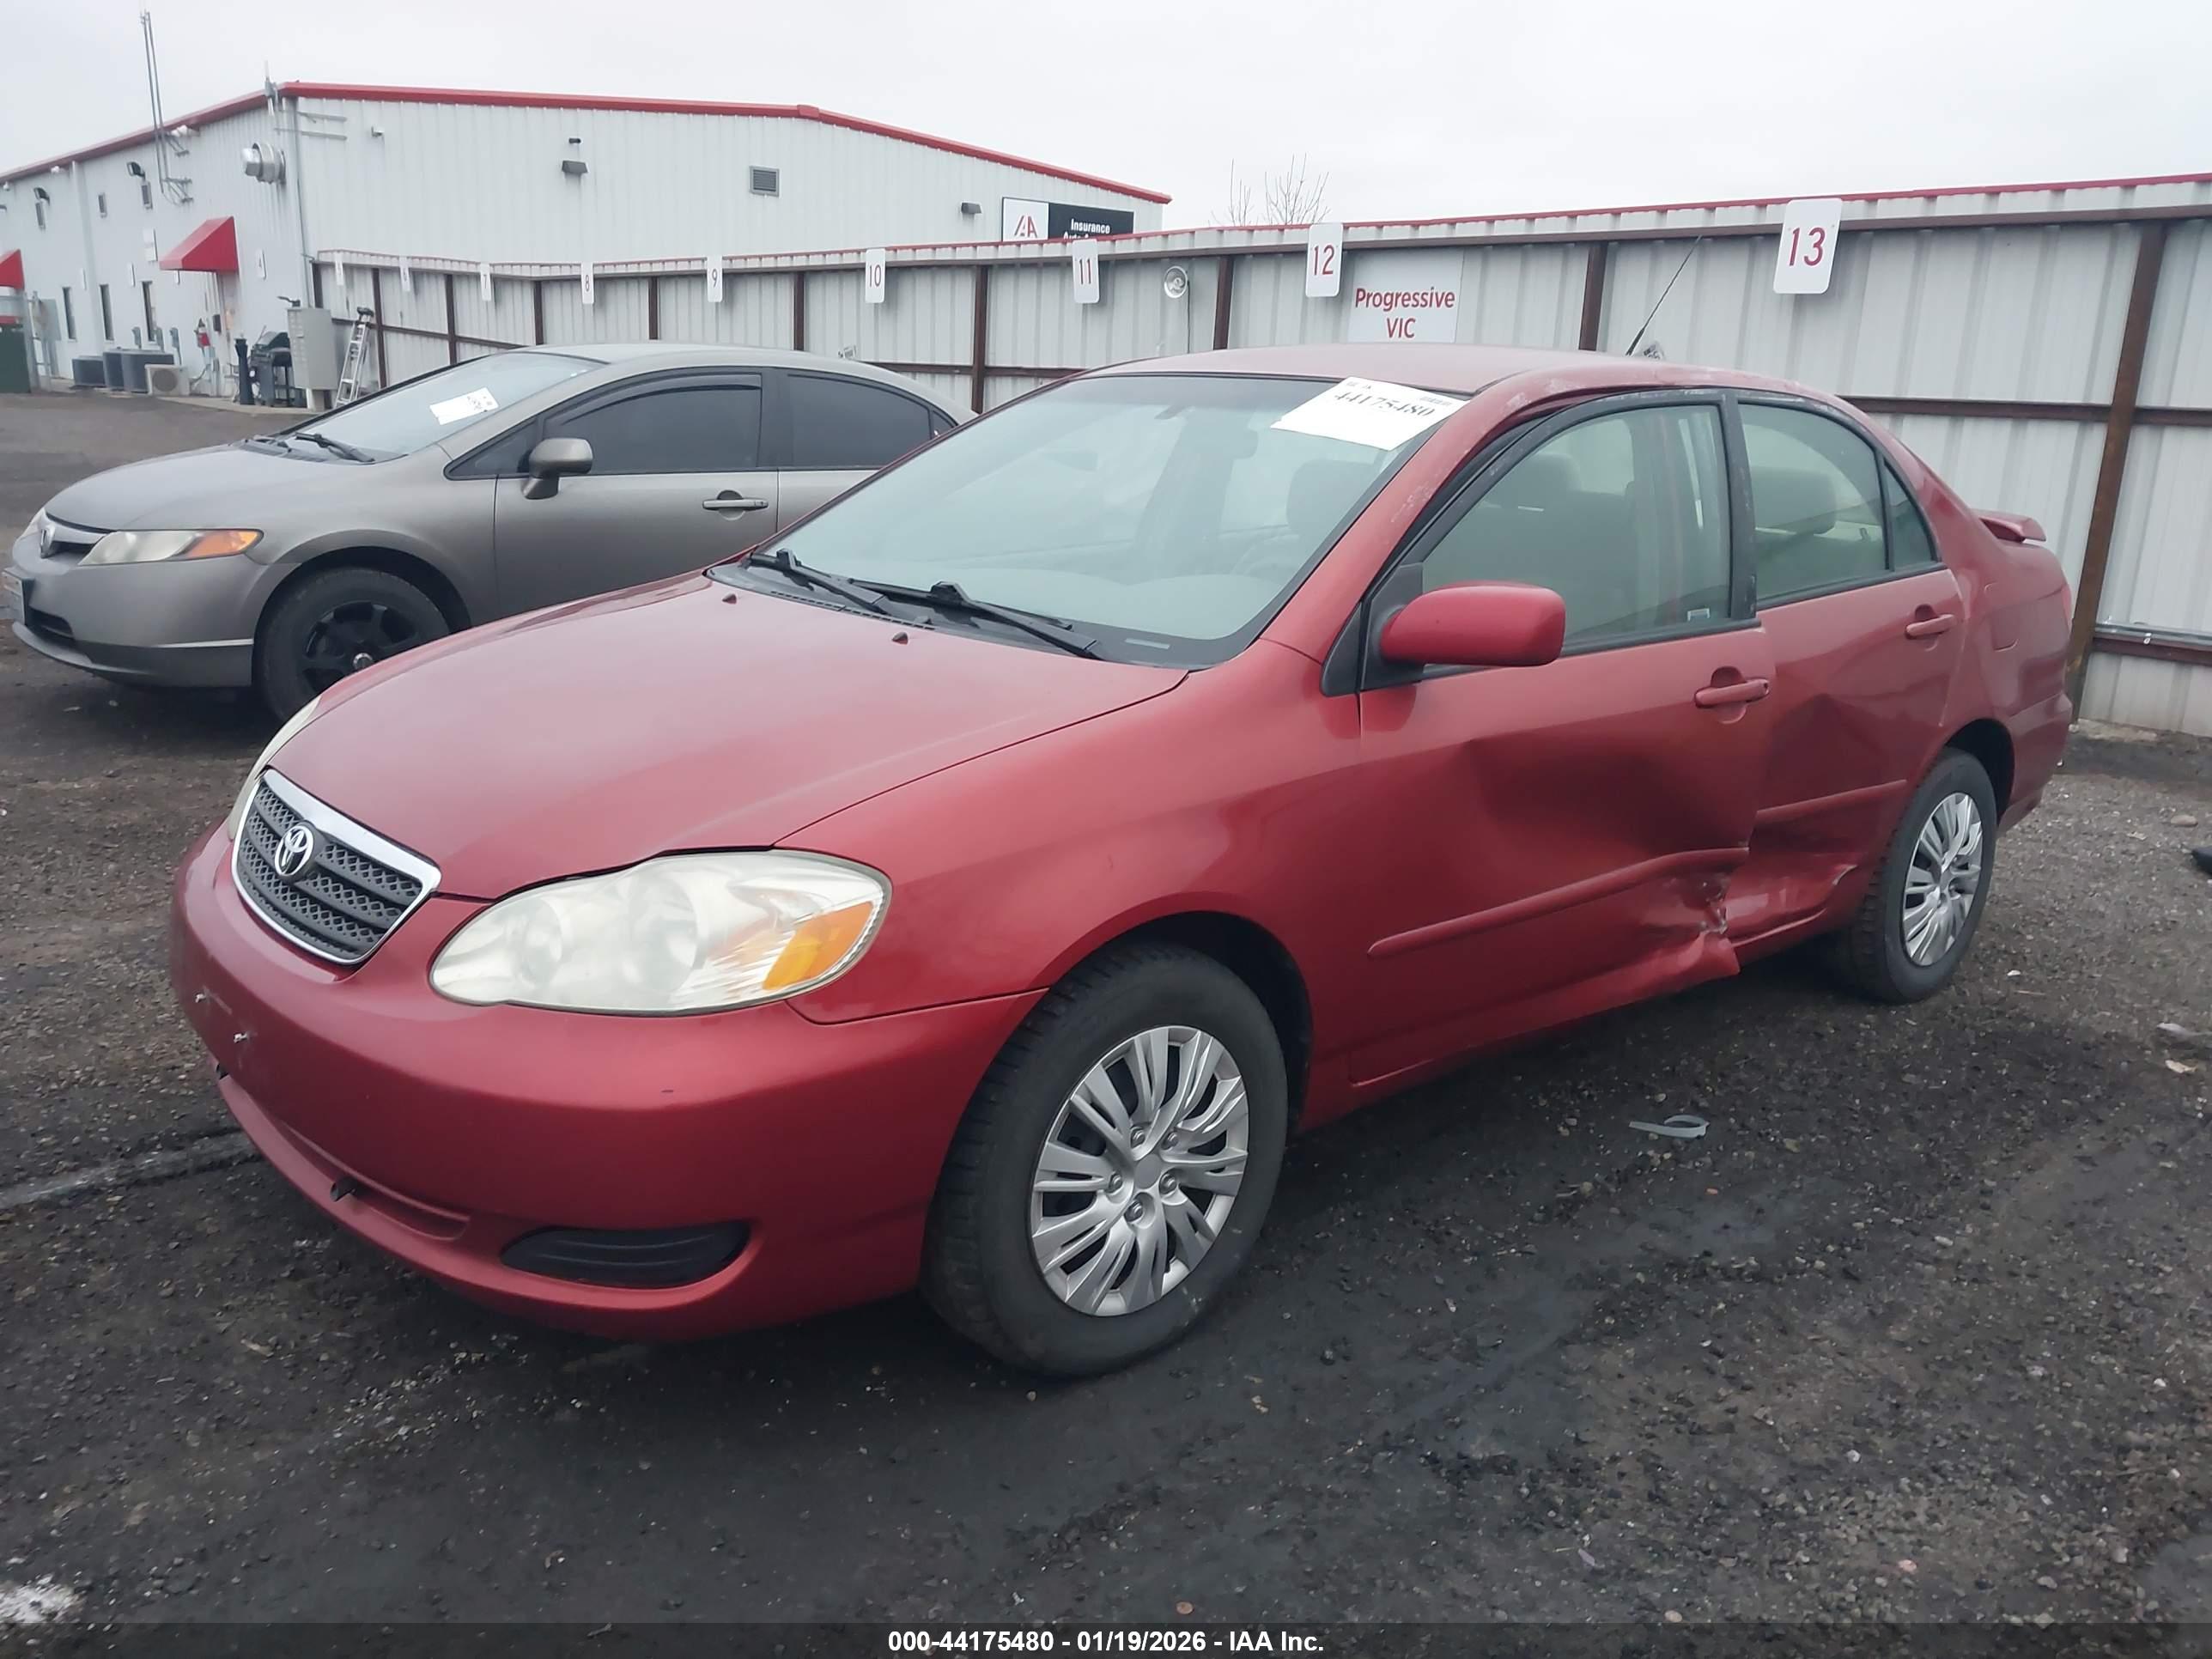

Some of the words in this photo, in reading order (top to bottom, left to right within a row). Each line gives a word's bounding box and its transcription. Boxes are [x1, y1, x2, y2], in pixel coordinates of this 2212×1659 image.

[1071, 218, 1110, 234] Insurance
[1789, 227, 1826, 266] 13
[1079, 258, 1091, 284] 11
[1314, 245, 1334, 275] 12
[483, 274, 488, 289] 7
[585, 275, 590, 292] 8
[712, 268, 717, 289] 9
[869, 264, 881, 288] 10
[1355, 286, 1455, 312] Progressive
[1387, 318, 1416, 338] VIC
[1334, 392, 1435, 416] 44175480
